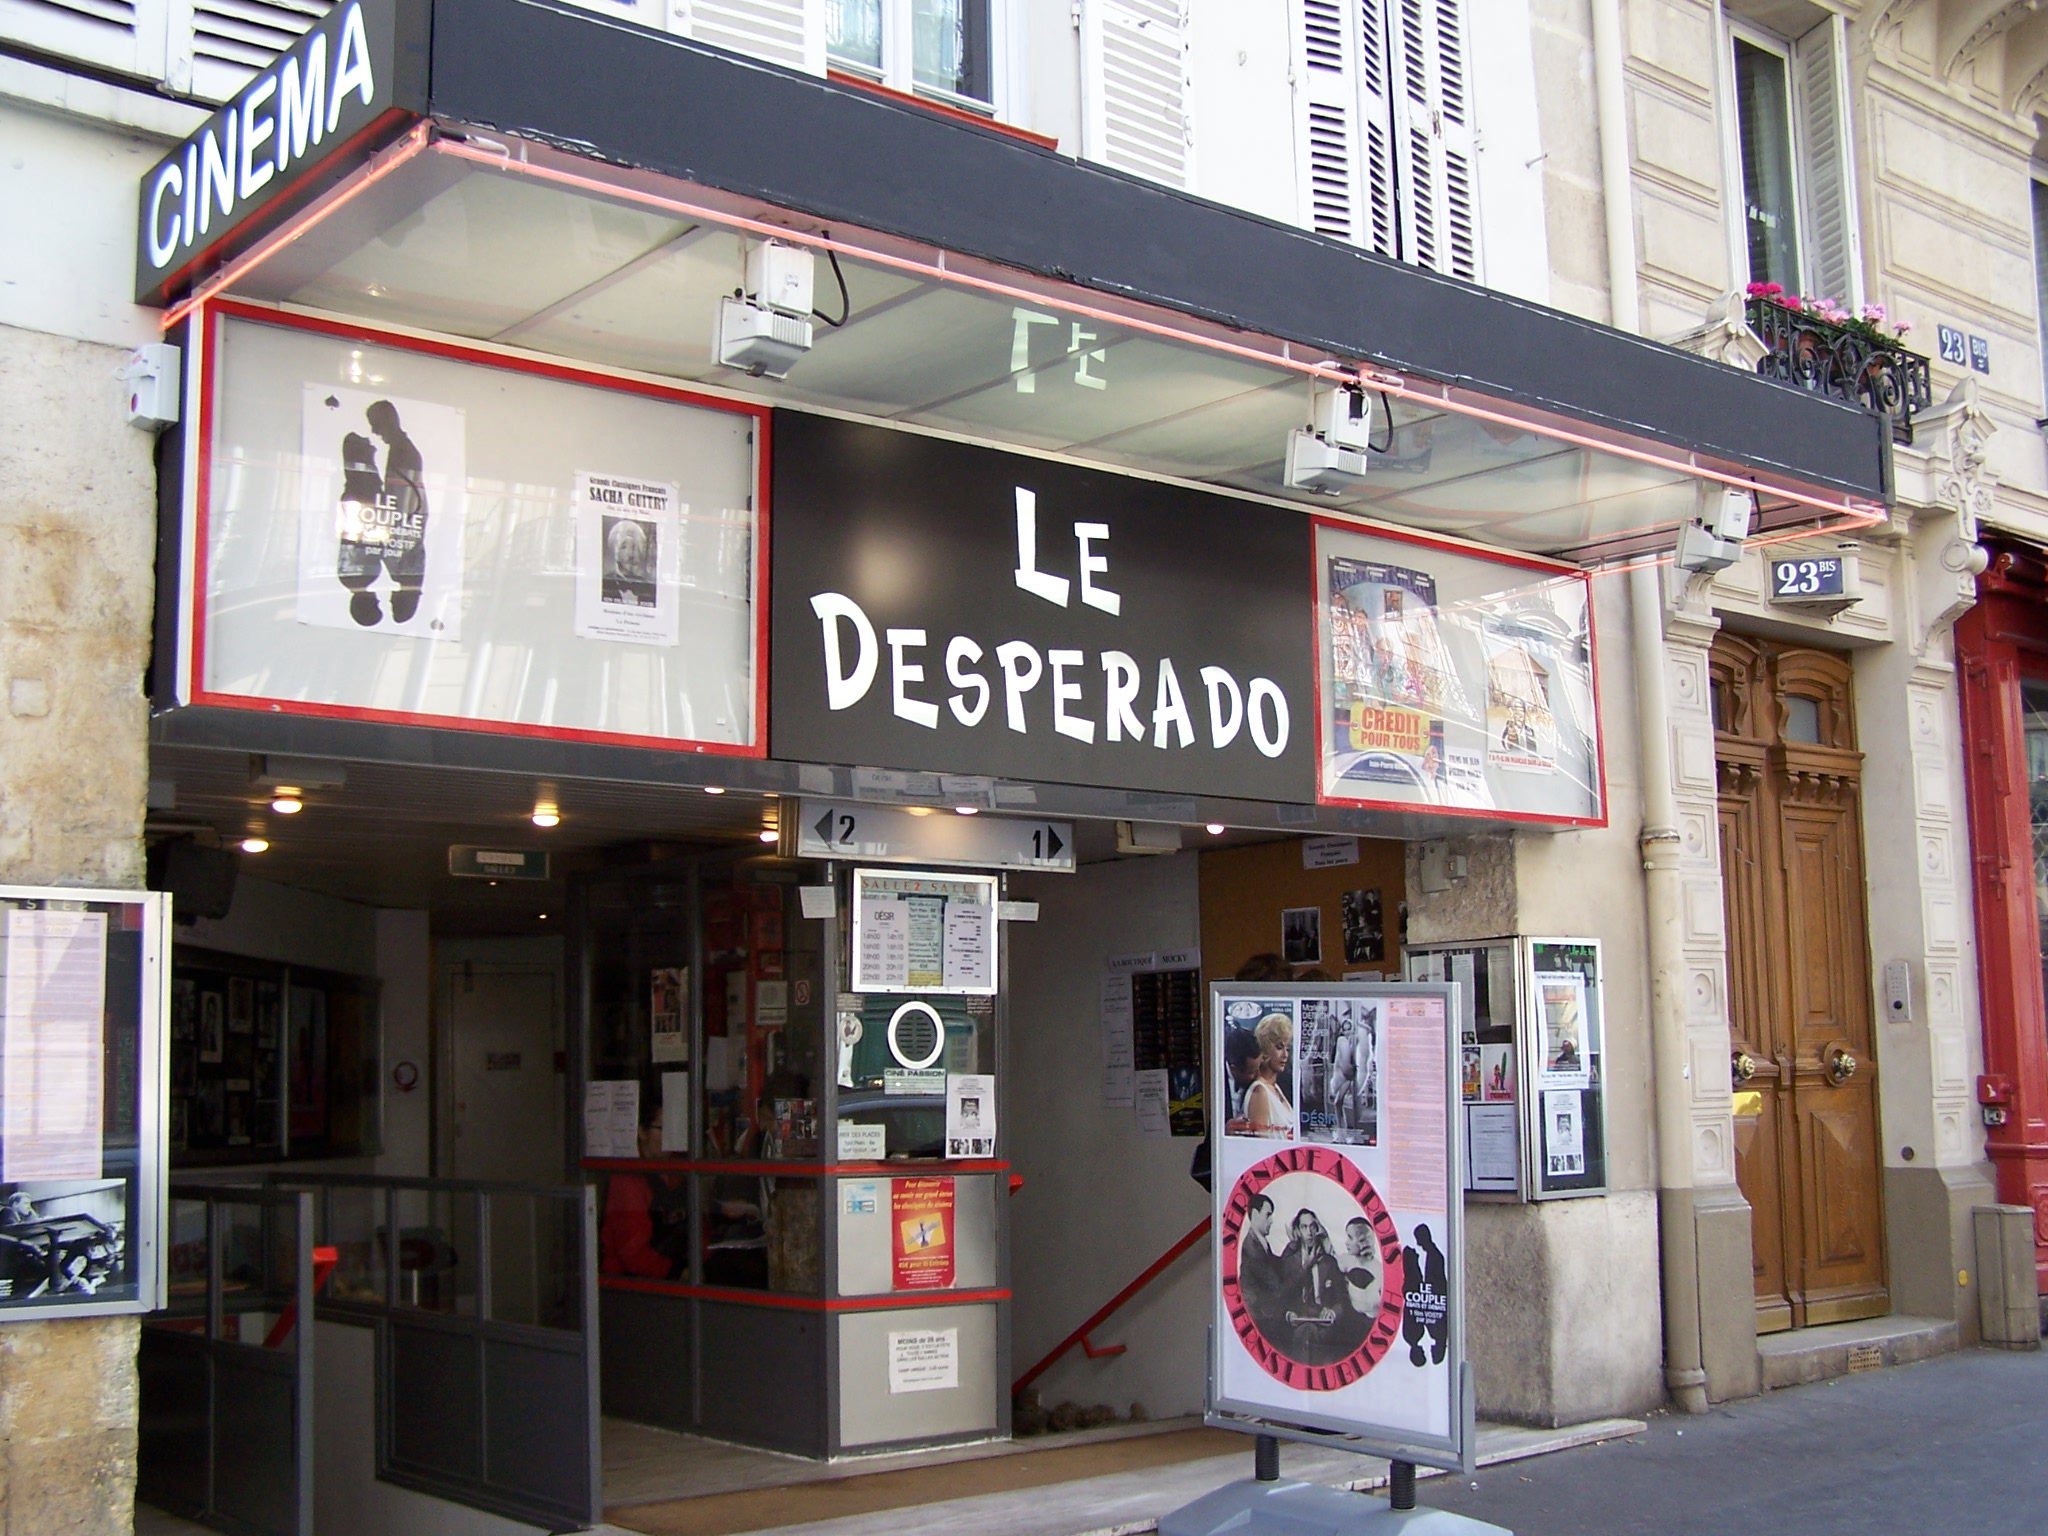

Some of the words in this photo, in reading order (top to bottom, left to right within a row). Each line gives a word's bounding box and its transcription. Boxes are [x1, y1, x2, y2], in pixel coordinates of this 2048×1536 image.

[147, 2, 374, 268] CINEMA
[1941, 328, 1965, 363] 23
[1971, 338, 1988, 358] BIS
[376, 493, 398, 511] LE
[589, 487, 624, 504] SACHA
[628, 493, 668, 511] GUITRY
[354, 507, 424, 529] OUPLE
[1015, 486, 1121, 617] LE
[1776, 561, 1820, 594] 23
[1819, 560, 1836, 572] BIS
[809, 592, 1290, 759] DESPERADO
[1361, 706, 1421, 735] CREDIT
[1360, 731, 1393, 747] POUR
[1393, 735, 1421, 751] TOUS
[839, 815, 855, 845] 2
[1032, 829, 1041, 858] 1
[862, 878, 912, 891] SALLE
[913, 881, 921, 892] 2
[874, 911, 895, 921] DÉSIR
[907, 1069, 945, 1078] PASSION
[1301, 1109, 1337, 1124] DÉSIR
[1222, 1149, 1322, 1250] SÉRÉNADE
[1350, 1171, 1402, 1265] TROIS
[1405, 1291, 1447, 1306] COUPLE
[1420, 1283, 1432, 1293] LE
[1306, 1288, 1403, 1391] LUBITSCH
